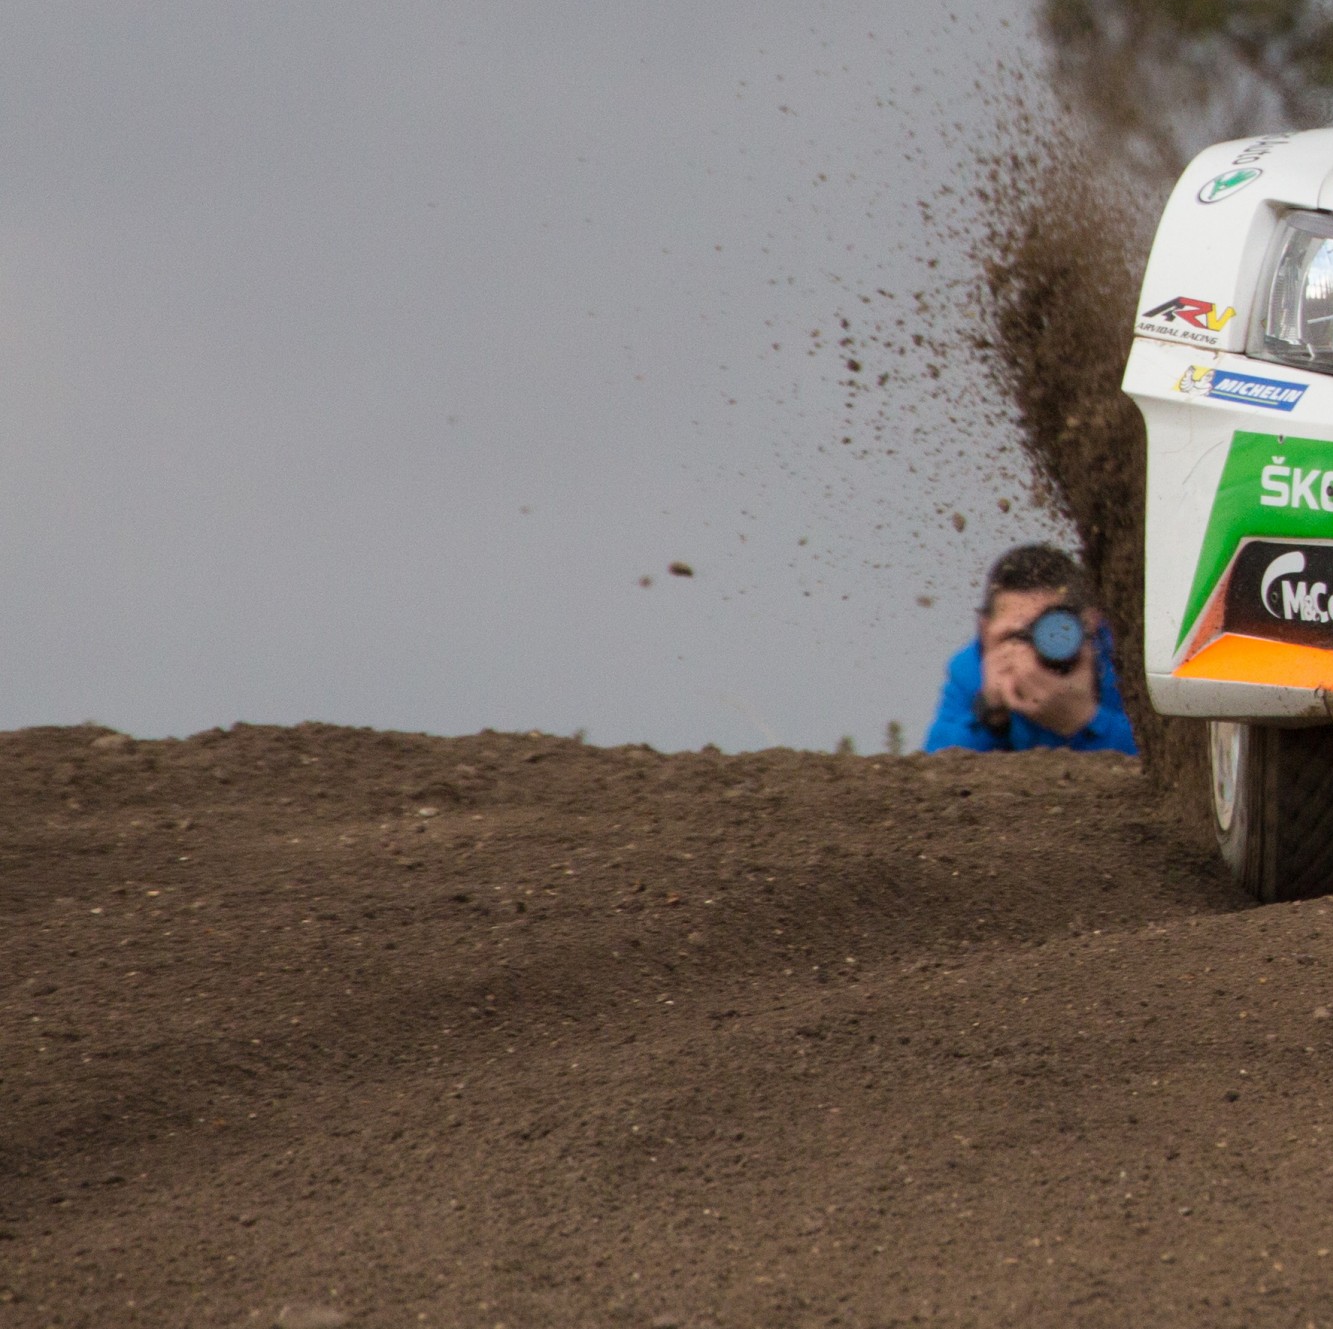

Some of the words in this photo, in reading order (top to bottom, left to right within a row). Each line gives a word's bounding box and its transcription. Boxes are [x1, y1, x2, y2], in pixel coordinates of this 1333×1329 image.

[1135, 322, 1180, 339] ARVIDAL
[1181, 331, 1218, 345] RACING
[1215, 378, 1301, 403] MICHELIN
